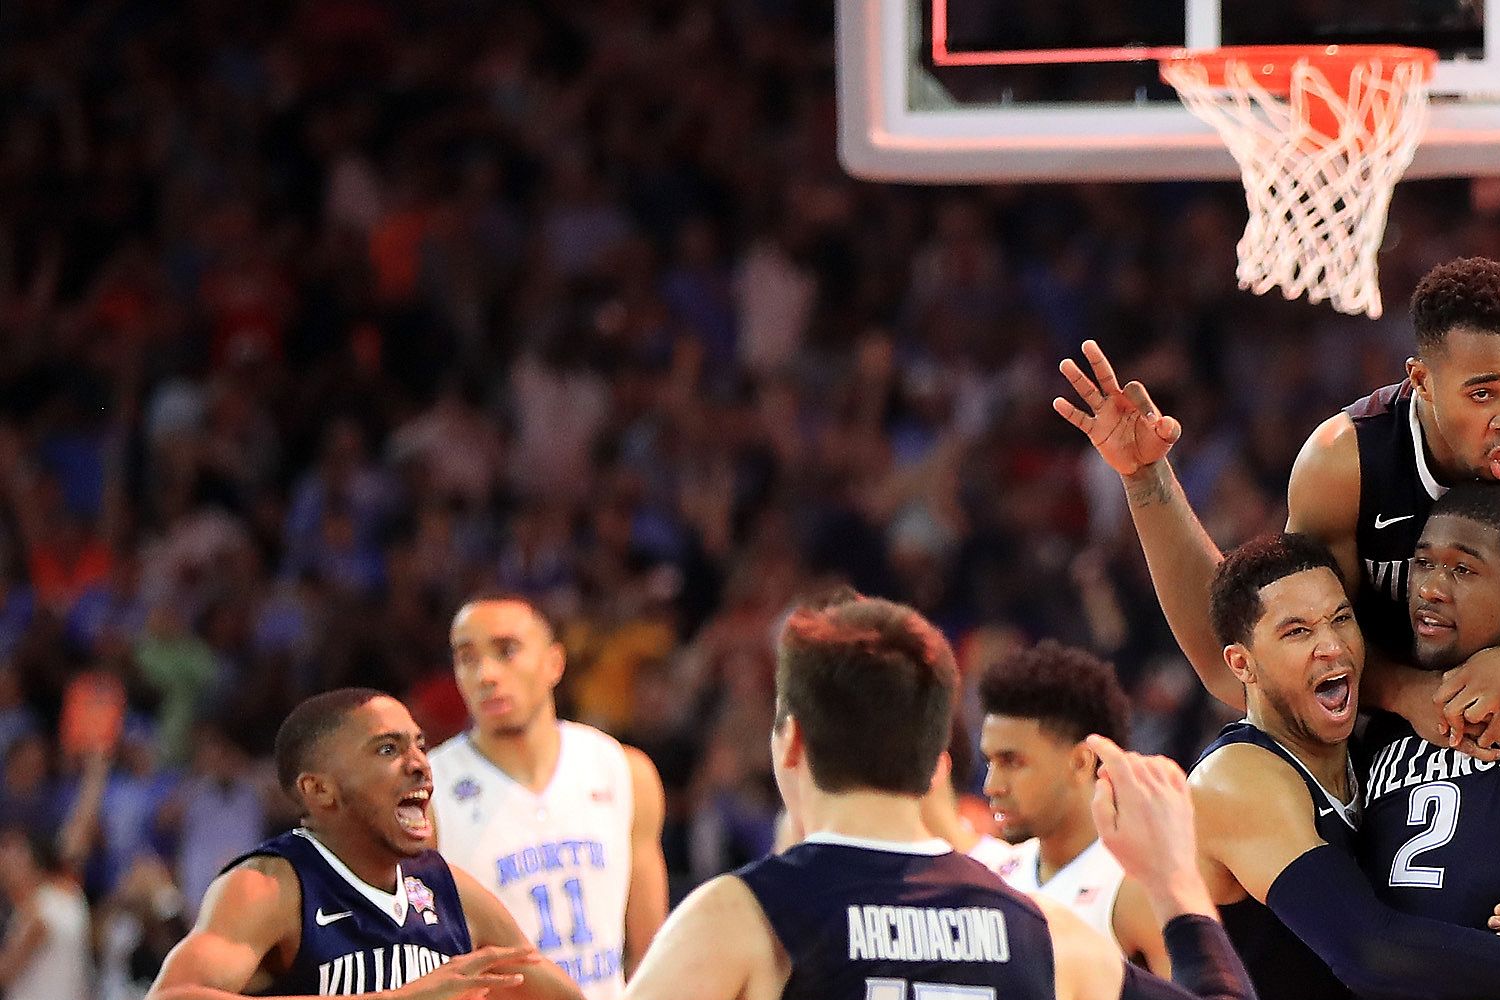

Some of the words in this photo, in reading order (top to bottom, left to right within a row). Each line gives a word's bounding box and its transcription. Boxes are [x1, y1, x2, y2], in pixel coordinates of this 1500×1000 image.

[496, 840, 606, 887] NORTH
[1388, 780, 1461, 889] 2
[530, 878, 593, 952] 11
[847, 904, 1011, 963] ARCIDIACONO
